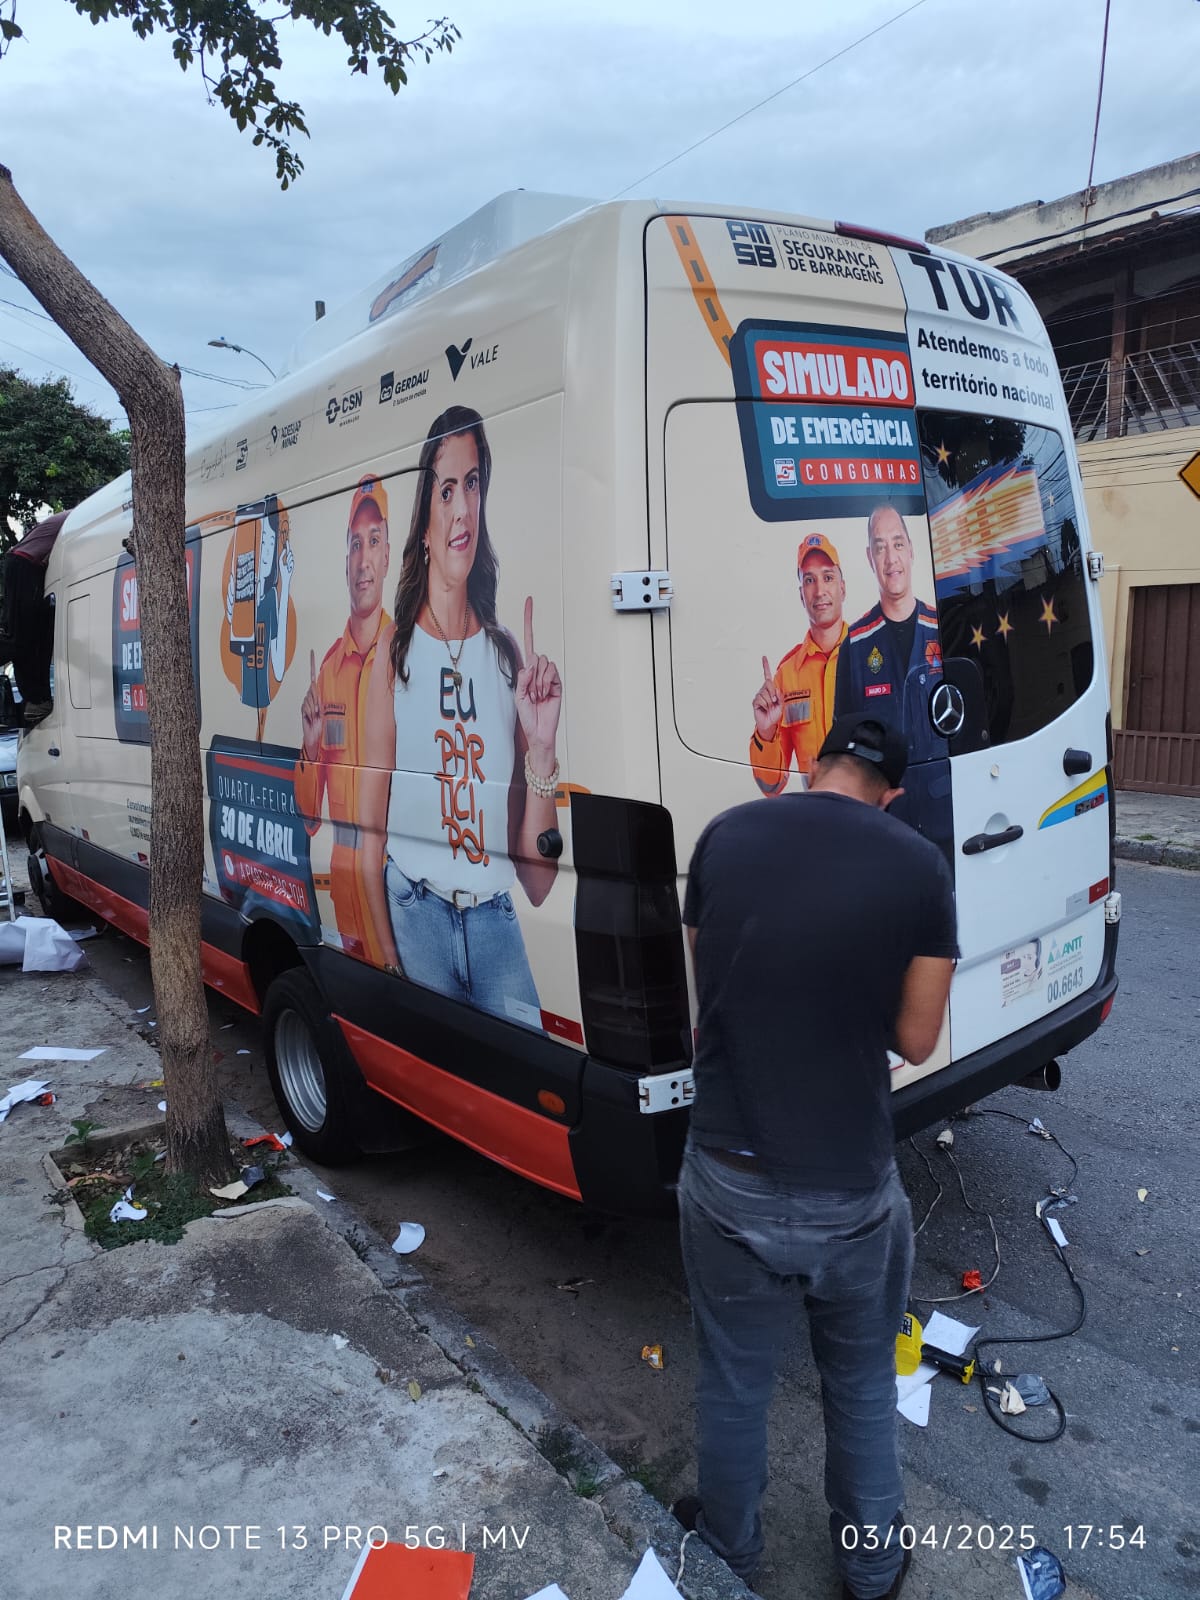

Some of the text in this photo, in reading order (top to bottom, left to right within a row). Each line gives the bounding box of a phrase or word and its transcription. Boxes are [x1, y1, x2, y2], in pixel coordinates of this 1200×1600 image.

[776, 226, 810, 240] PLANO
[811, 232, 859, 250] MUNICIPAL
[783, 239, 879, 269] SEGURANÇA
[787, 256, 884, 285] DE BARRAGENS
[908, 253, 1024, 334] TUR
[470, 344, 499, 370] VALE
[917, 327, 1049, 377] Atendemos a todo
[394, 369, 430, 395] GERDAU
[763, 350, 908, 400] SIMULADO
[922, 367, 1055, 411] território nacional
[342, 390, 363, 414] CSN
[770, 412, 914, 447] DE EMERGÊNCIA
[805, 463, 917, 481] CONGONHAS
[440, 667, 477, 723] EU
[434, 722, 486, 784] PAR
[218, 775, 296, 817] QUARTA-FEIRA
[433, 771, 476, 824] TICI
[220, 804, 299, 866] 30 DE ABRIL
[1062, 935, 1083, 957] ANTT
[1047, 966, 1083, 1004] 00.6643
